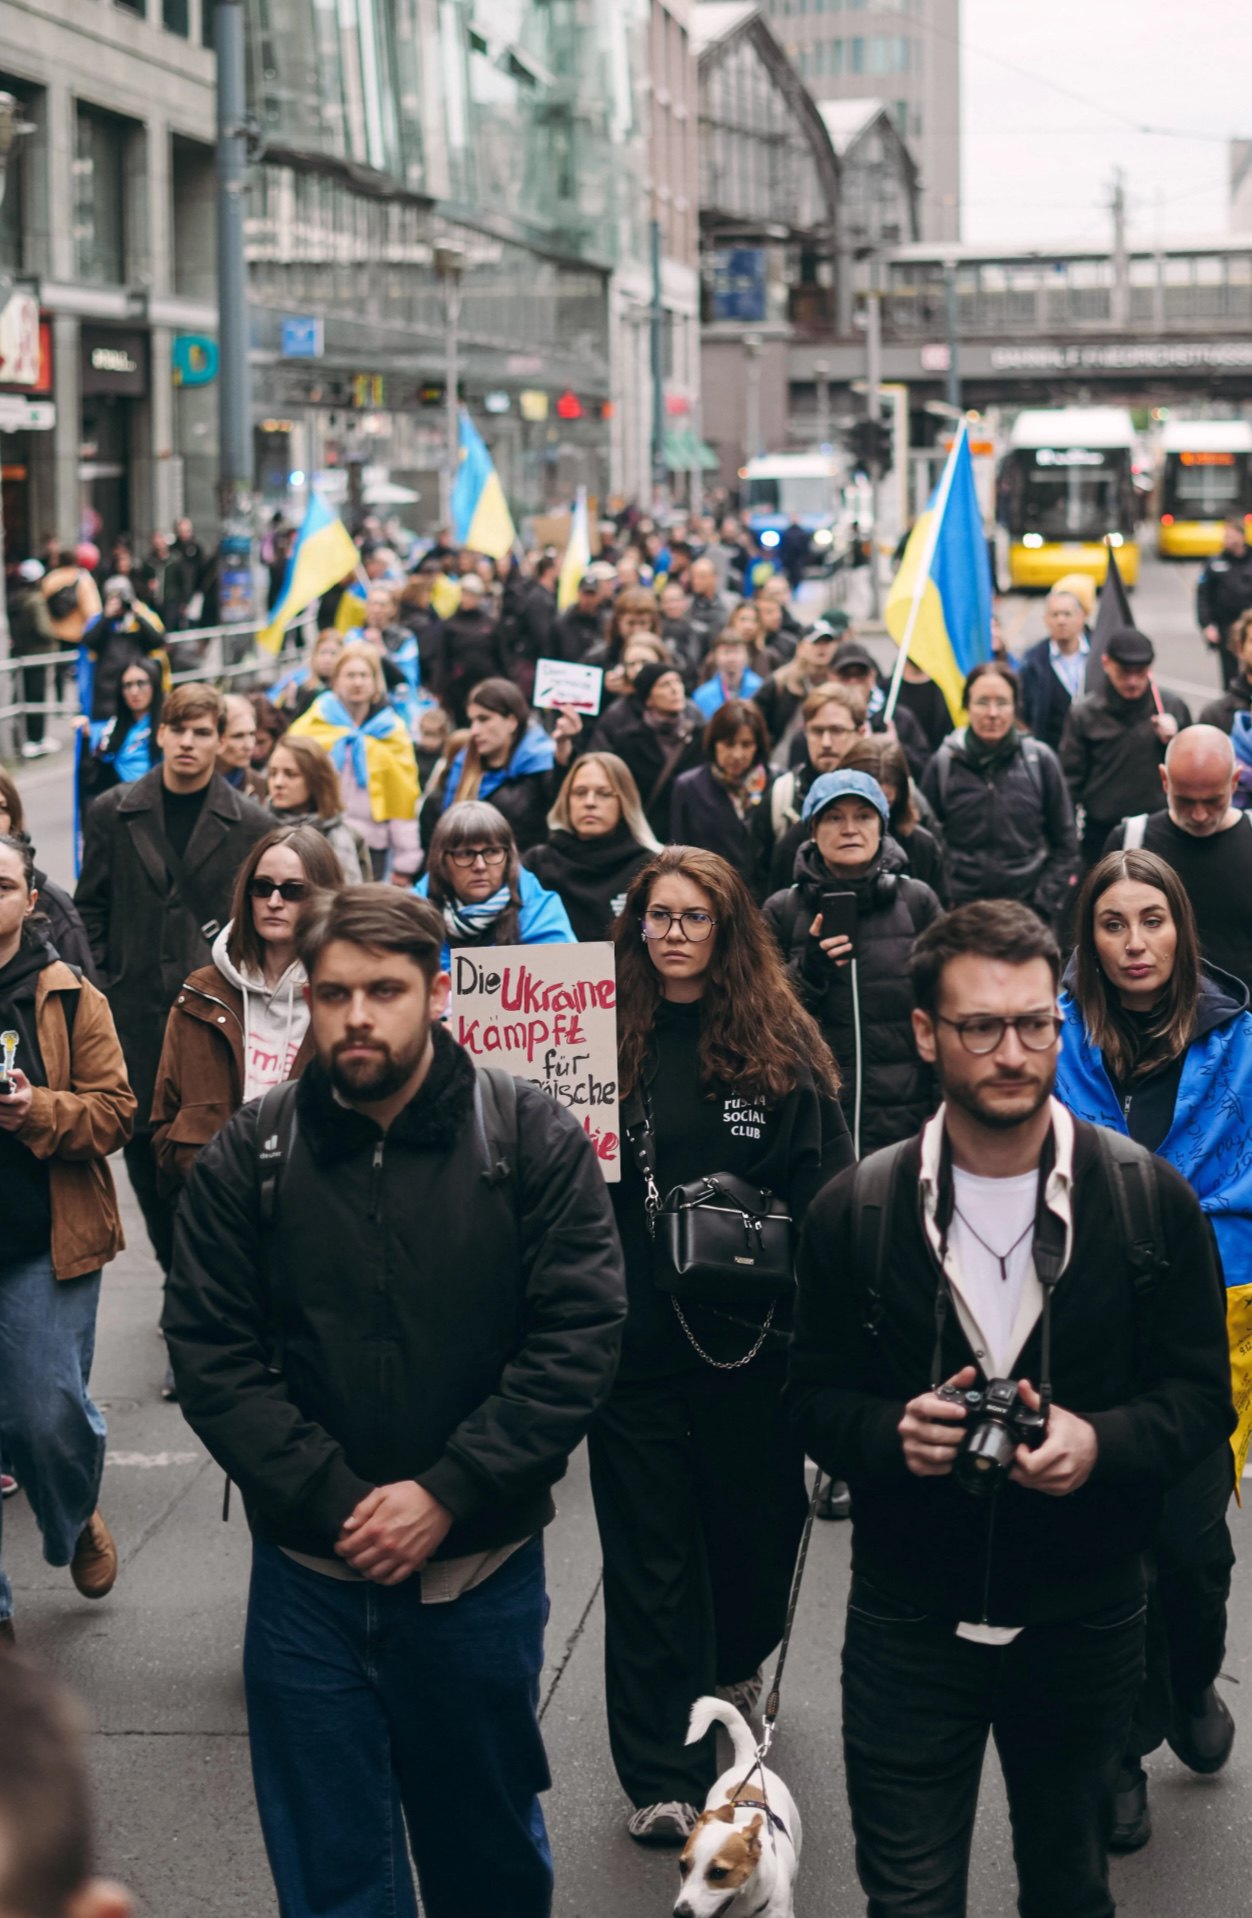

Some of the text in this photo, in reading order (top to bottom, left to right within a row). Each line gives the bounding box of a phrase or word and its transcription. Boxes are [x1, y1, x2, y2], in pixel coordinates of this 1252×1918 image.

[455, 955, 616, 1014] Die Ukraine
[543, 1049, 591, 1079] für
[731, 1125, 761, 1139] CLUB
